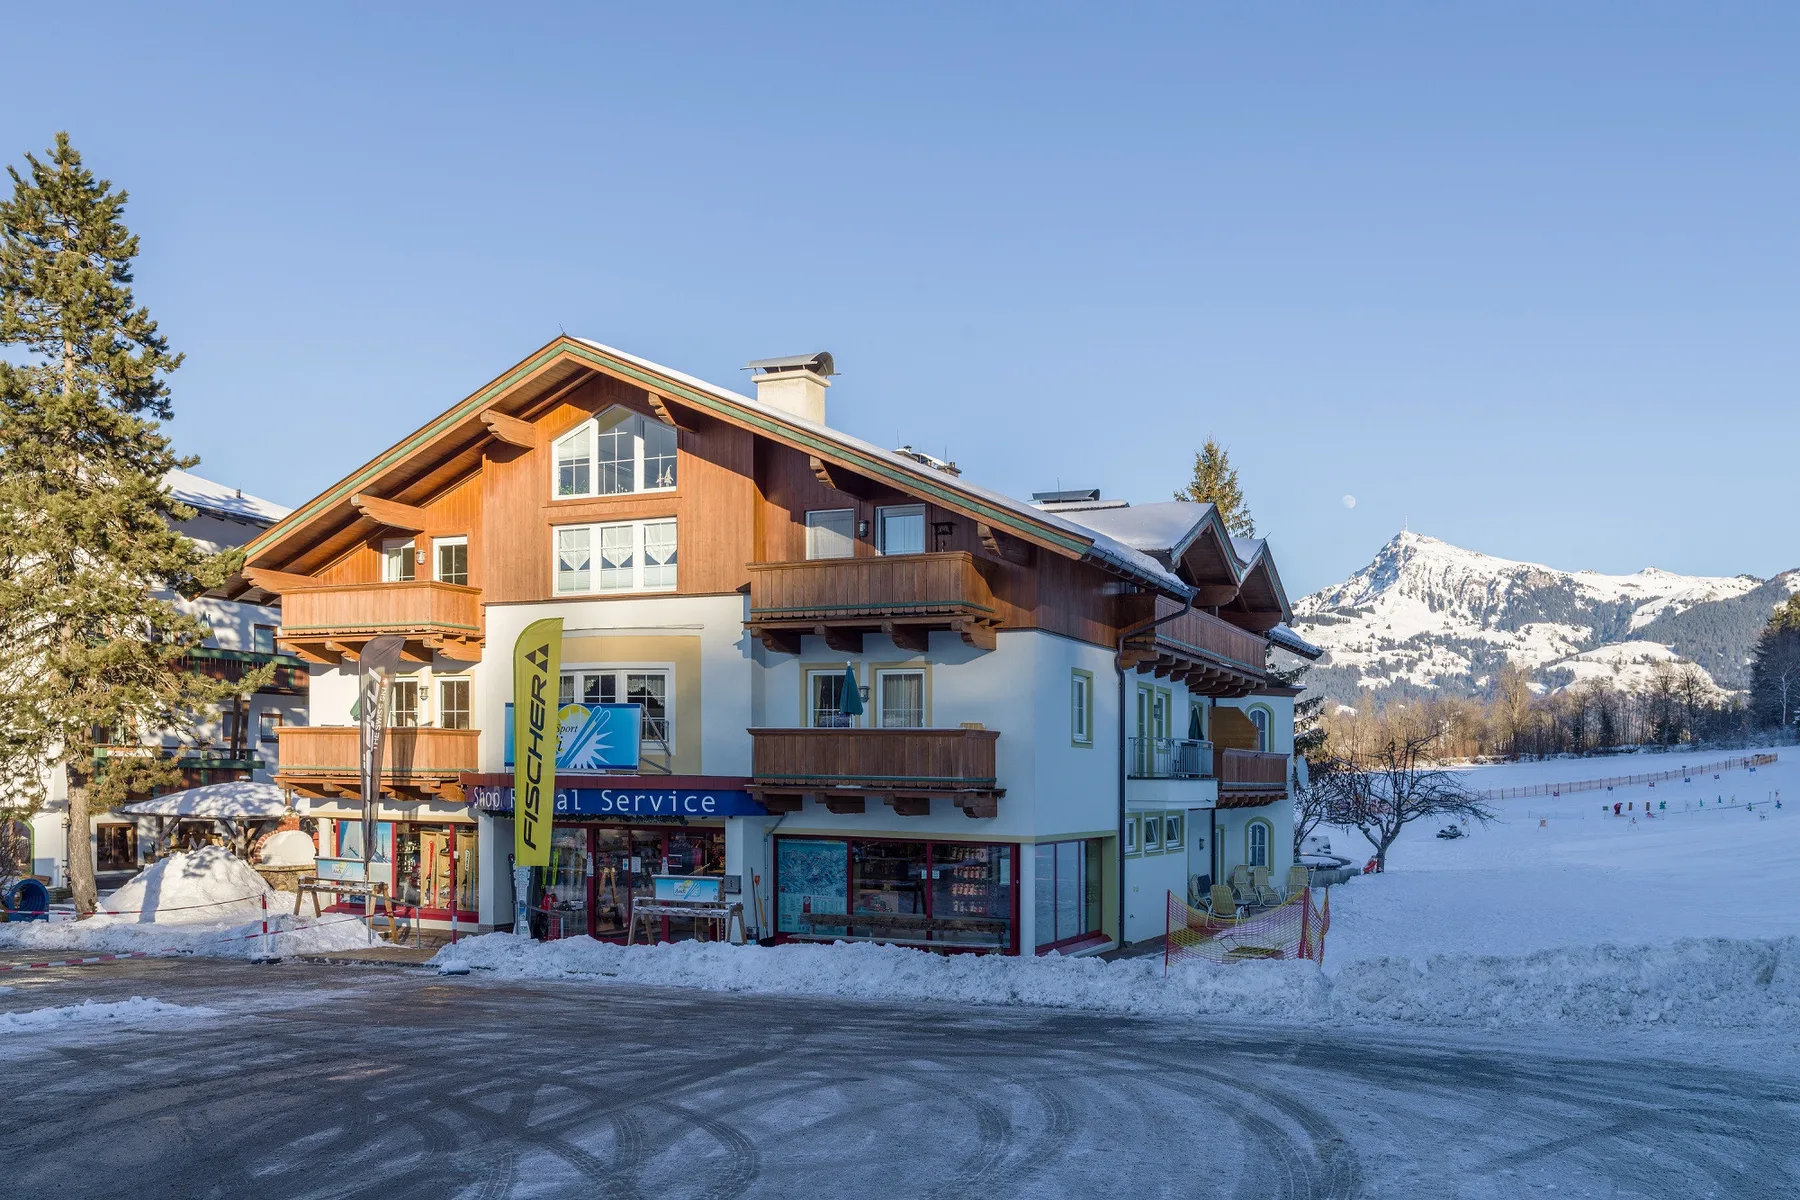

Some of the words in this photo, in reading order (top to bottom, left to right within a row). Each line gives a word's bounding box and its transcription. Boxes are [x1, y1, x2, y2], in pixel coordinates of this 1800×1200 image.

[375, 703, 384, 731] SWISS
[523, 674, 547, 850] FISCHER
[474, 787, 500, 810] Shop
[601, 790, 715, 812] Service
